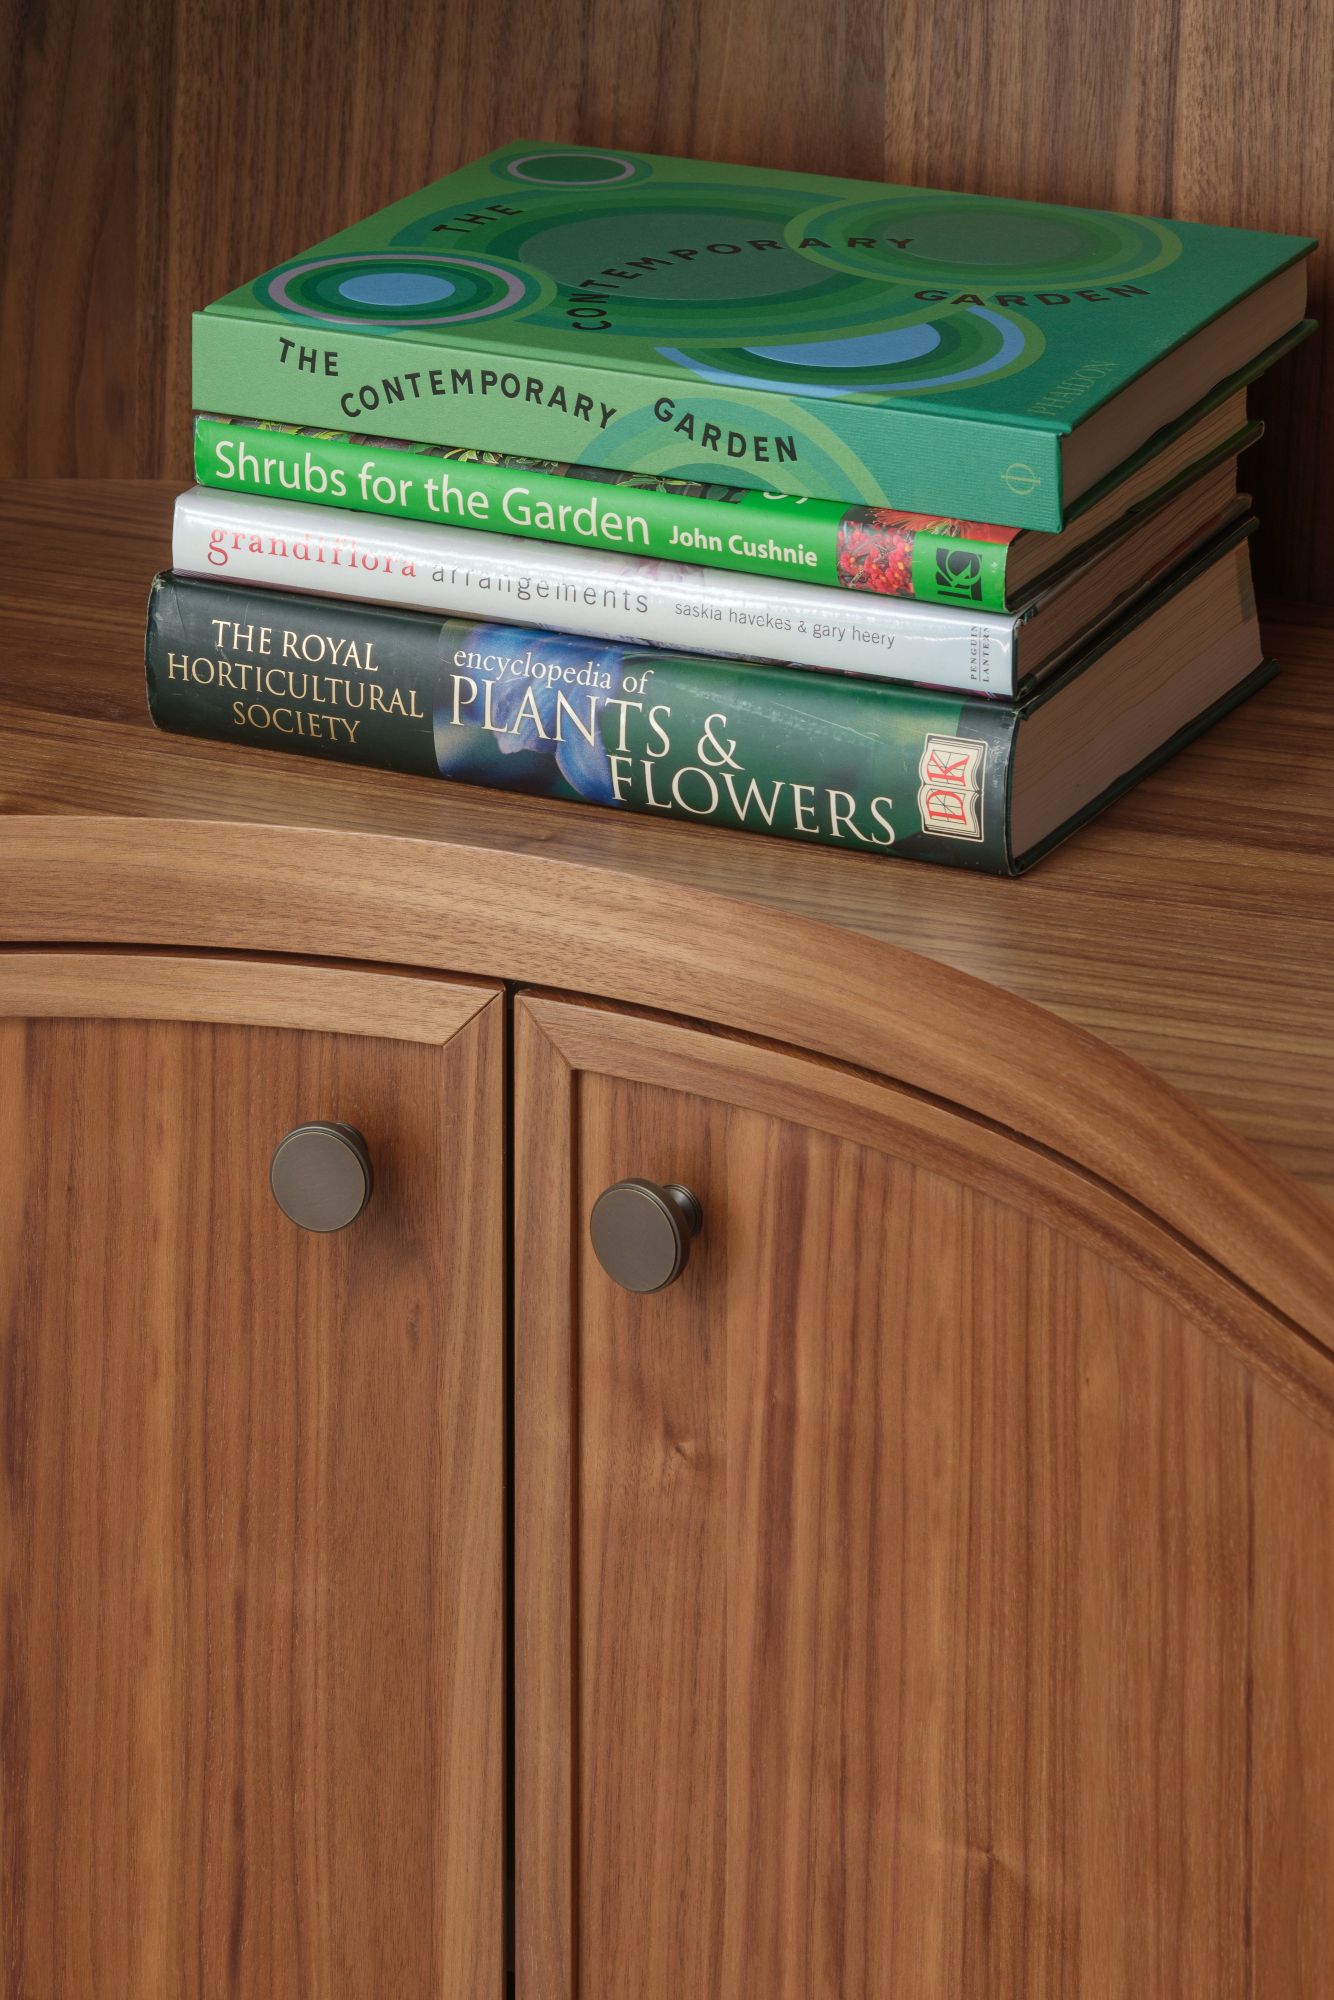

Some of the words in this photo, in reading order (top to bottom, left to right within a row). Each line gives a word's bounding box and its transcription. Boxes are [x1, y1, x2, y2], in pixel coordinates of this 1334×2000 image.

[432, 204, 525, 236] THE
[567, 237, 914, 330] CONTEMPORARY
[914, 284, 1151, 307] GARDEN
[278, 337, 339, 377] THE
[340, 368, 618, 430] CONTEMPORARY
[1027, 360, 1120, 416] PHAIDON
[654, 397, 798, 463] GARDEN
[215, 440, 346, 496] Shrubs
[358, 461, 412, 506] for
[424, 474, 489, 519] the
[502, 488, 650, 546] Garden
[207, 528, 417, 578] grandiflora
[431, 562, 649, 613] arrangements
[669, 525, 722, 552] John
[728, 534, 818, 567] Cushnie
[212, 619, 272, 654] THE
[282, 630, 379, 672] ROYAL
[675, 600, 722, 621] saskia
[729, 607, 792, 632] havekes
[797, 619, 807, 634] &
[812, 623, 846, 643] gary
[851, 626, 895, 649] heery
[453, 649, 611, 690] encyclopedia
[622, 670, 654, 694] of
[970, 625, 978, 681] PENGUIN
[981, 627, 990, 683] LANTERN
[167, 653, 424, 719] HORTICULTURAL
[233, 701, 361, 744] SOCIETY
[449, 674, 671, 758] PLANTS
[697, 713, 745, 771] &
[607, 754, 895, 846] FLOWERS
[926, 753, 970, 825] DK
